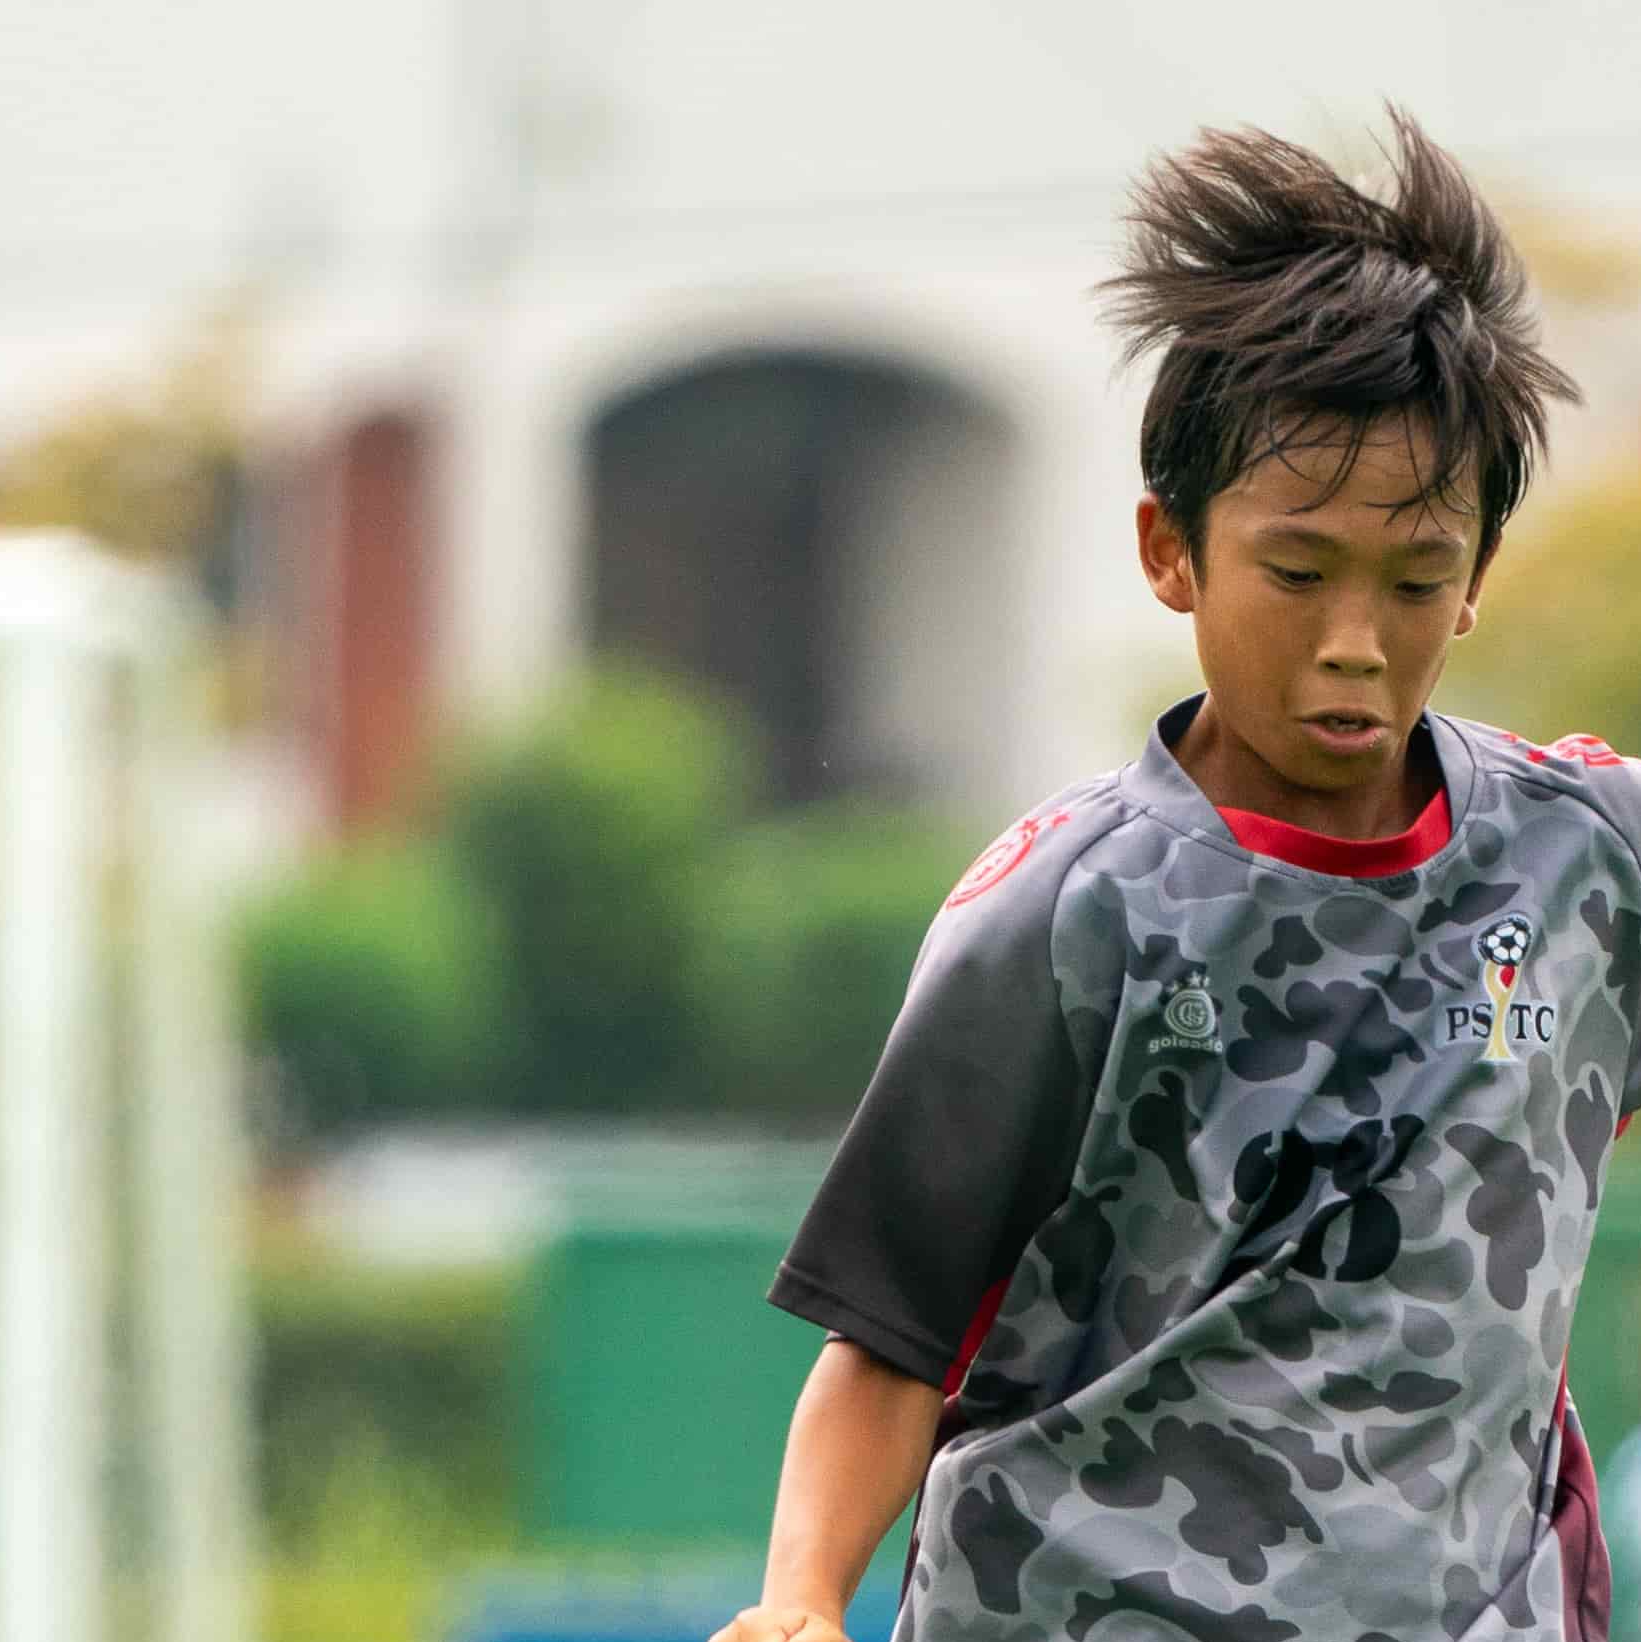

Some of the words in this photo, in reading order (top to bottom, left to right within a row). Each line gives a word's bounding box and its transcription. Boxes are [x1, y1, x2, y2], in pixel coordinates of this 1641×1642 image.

[1445, 1002, 1493, 1041] PS
[1509, 1002, 1555, 1043] TC
[1147, 1034, 1224, 1055] goleada
